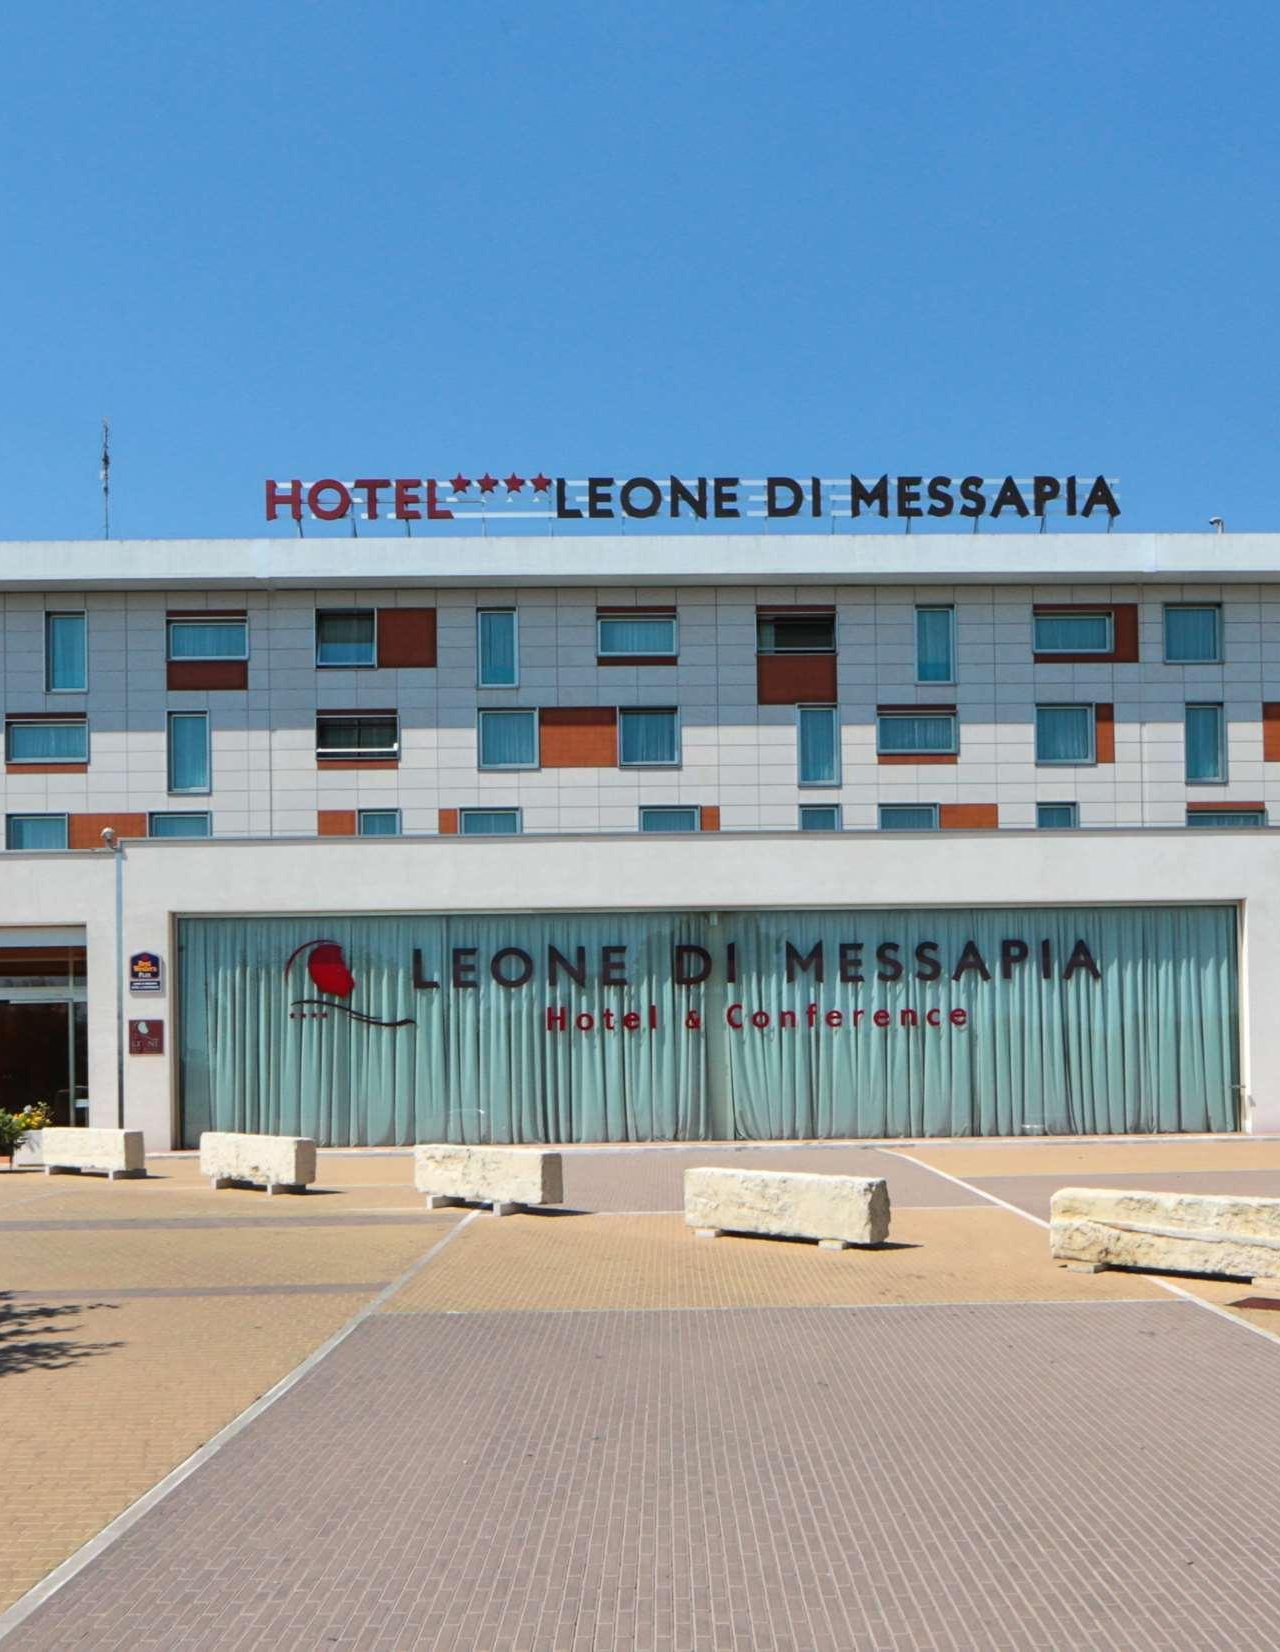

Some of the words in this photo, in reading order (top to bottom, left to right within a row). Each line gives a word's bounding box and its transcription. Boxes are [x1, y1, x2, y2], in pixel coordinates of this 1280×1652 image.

[265, 478, 454, 521] HOTEL
[556, 475, 740, 520] LEONE
[767, 476, 821, 519] DI
[850, 474, 1121, 519] MESSAPIA
[412, 944, 629, 988] LEONE
[674, 942, 737, 986] DI
[785, 938, 1102, 984] MESSAPIA
[545, 1004, 659, 1032] Hotel
[685, 1009, 702, 1030] &
[725, 1002, 968, 1030] Conference
